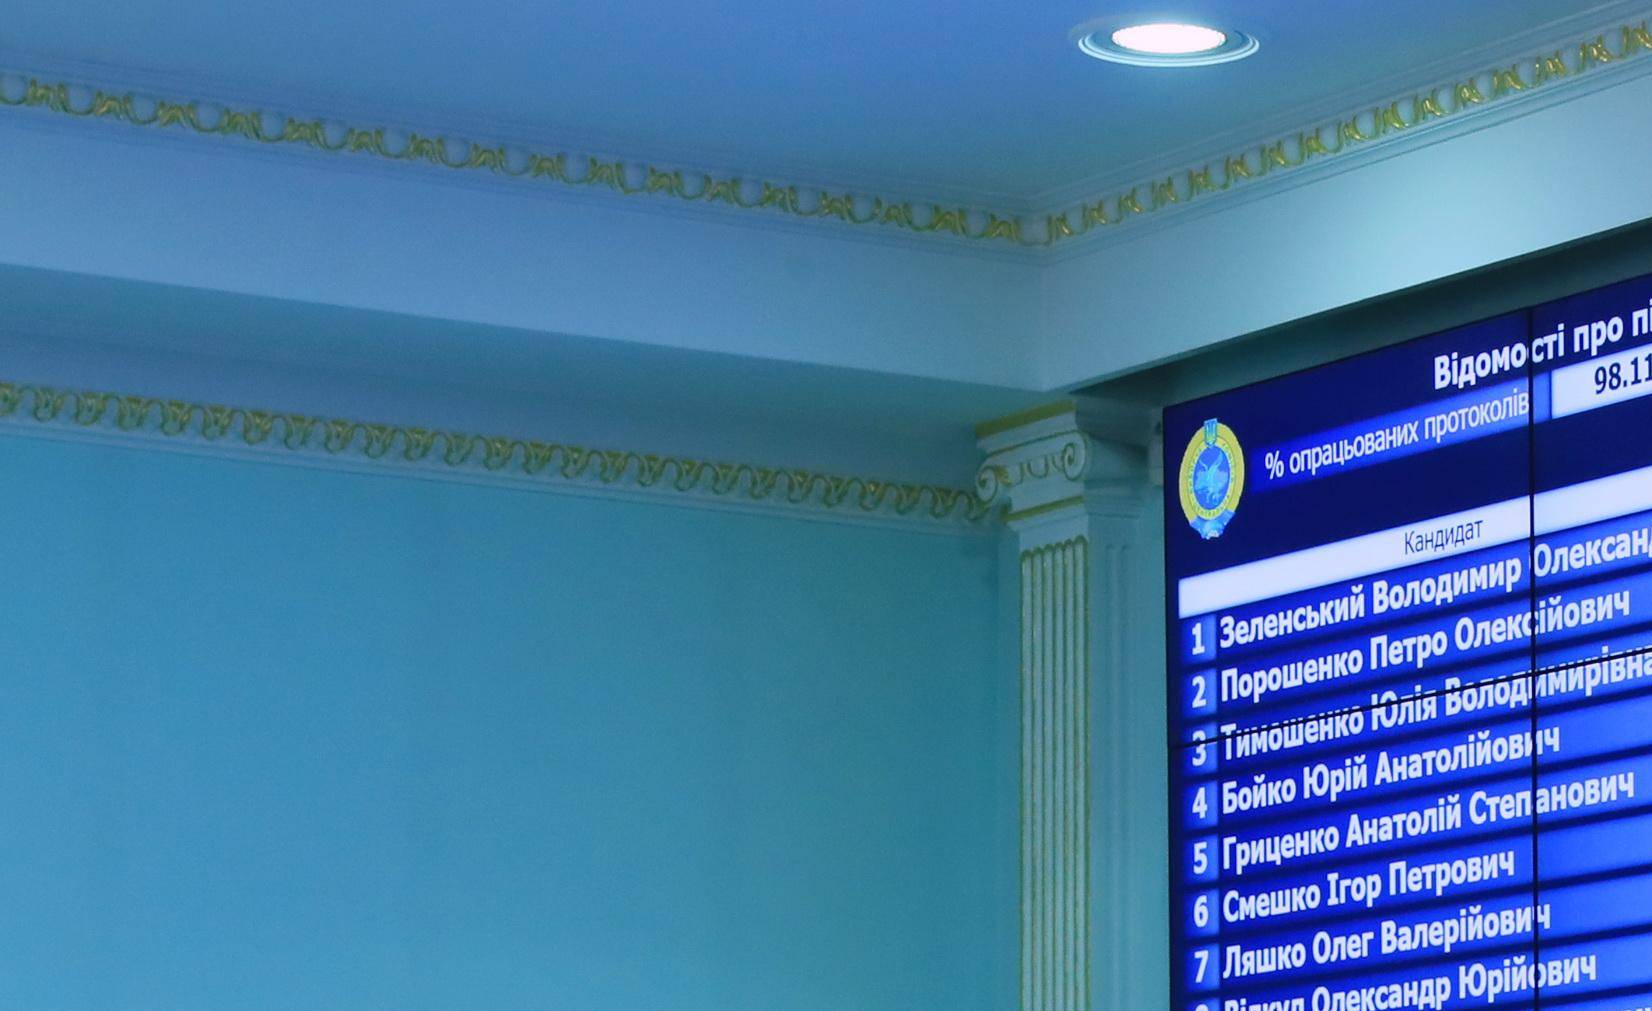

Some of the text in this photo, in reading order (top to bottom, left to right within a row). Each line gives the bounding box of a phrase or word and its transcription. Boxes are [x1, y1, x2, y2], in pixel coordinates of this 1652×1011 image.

[1434, 322, 1564, 390] Відомості
[1573, 315, 1623, 356] про
[1264, 449, 1284, 480] %
[1288, 420, 1419, 476] опрацьованих
[1424, 387, 1529, 443] протоколів
[1404, 519, 1483, 555] Кандидат
[1191, 621, 1205, 655] 1
[1219, 586, 1365, 648] Зеленський
[1372, 556, 1522, 614] Володимир
[1191, 674, 1207, 708] 2
[1220, 648, 1363, 703] Порошенко
[1369, 630, 1448, 670] Петро
[1454, 589, 1630, 650] Олексійович
[1191, 729, 1208, 766] 3
[1219, 704, 1364, 760] Тимошенко
[1370, 684, 1437, 731] Юлія
[1191, 786, 1208, 819] 4
[1222, 773, 1296, 814] Бойко
[1302, 753, 1367, 802] Юрій
[1373, 726, 1559, 785] Анатолійович
[1192, 840, 1208, 874] 5
[1222, 825, 1339, 875] Гриценко
[1345, 793, 1461, 848] Анатолій
[1468, 771, 1634, 825] Степанович
[1193, 894, 1209, 927] 6
[1222, 883, 1321, 922] Смешко
[1326, 871, 1382, 907] Ігор
[1388, 850, 1514, 896] Петрович
[1193, 949, 1209, 983] 7
[1222, 942, 1306, 979] Ляшко
[1312, 930, 1374, 964] Олег
[1380, 902, 1551, 954] Валерійович
[1458, 954, 1596, 1003] Юрійович
